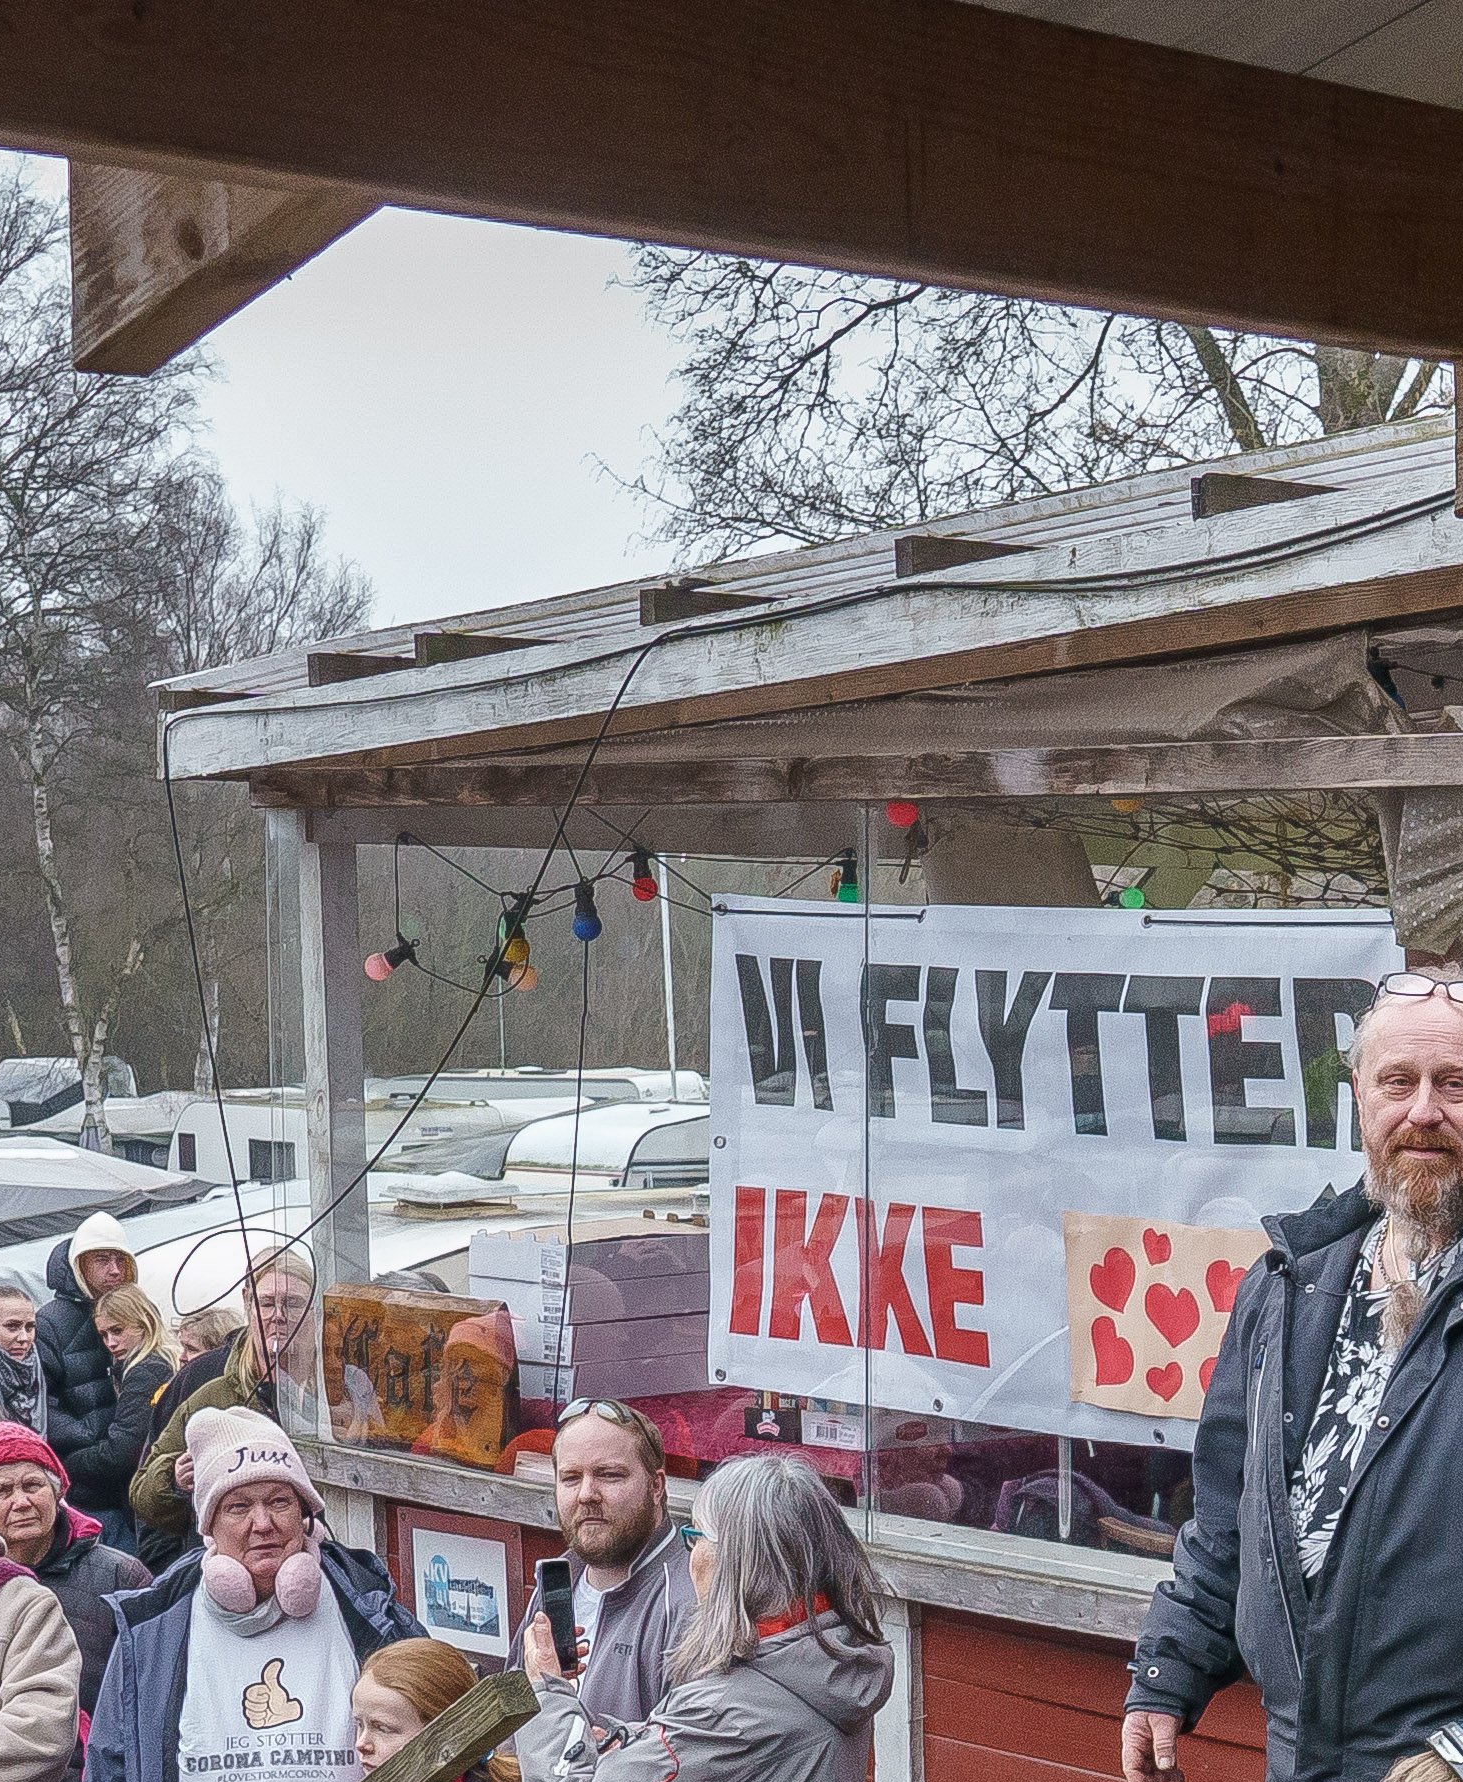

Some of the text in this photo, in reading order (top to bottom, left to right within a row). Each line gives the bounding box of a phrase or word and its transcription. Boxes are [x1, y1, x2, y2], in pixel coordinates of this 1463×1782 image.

[735, 954, 1377, 1152] VI FLYTTER
[728, 1185, 991, 1368] IKKE
[186, 1750, 264, 1773] CORONA
[226, 1732, 326, 1751] JEG STØTTER
